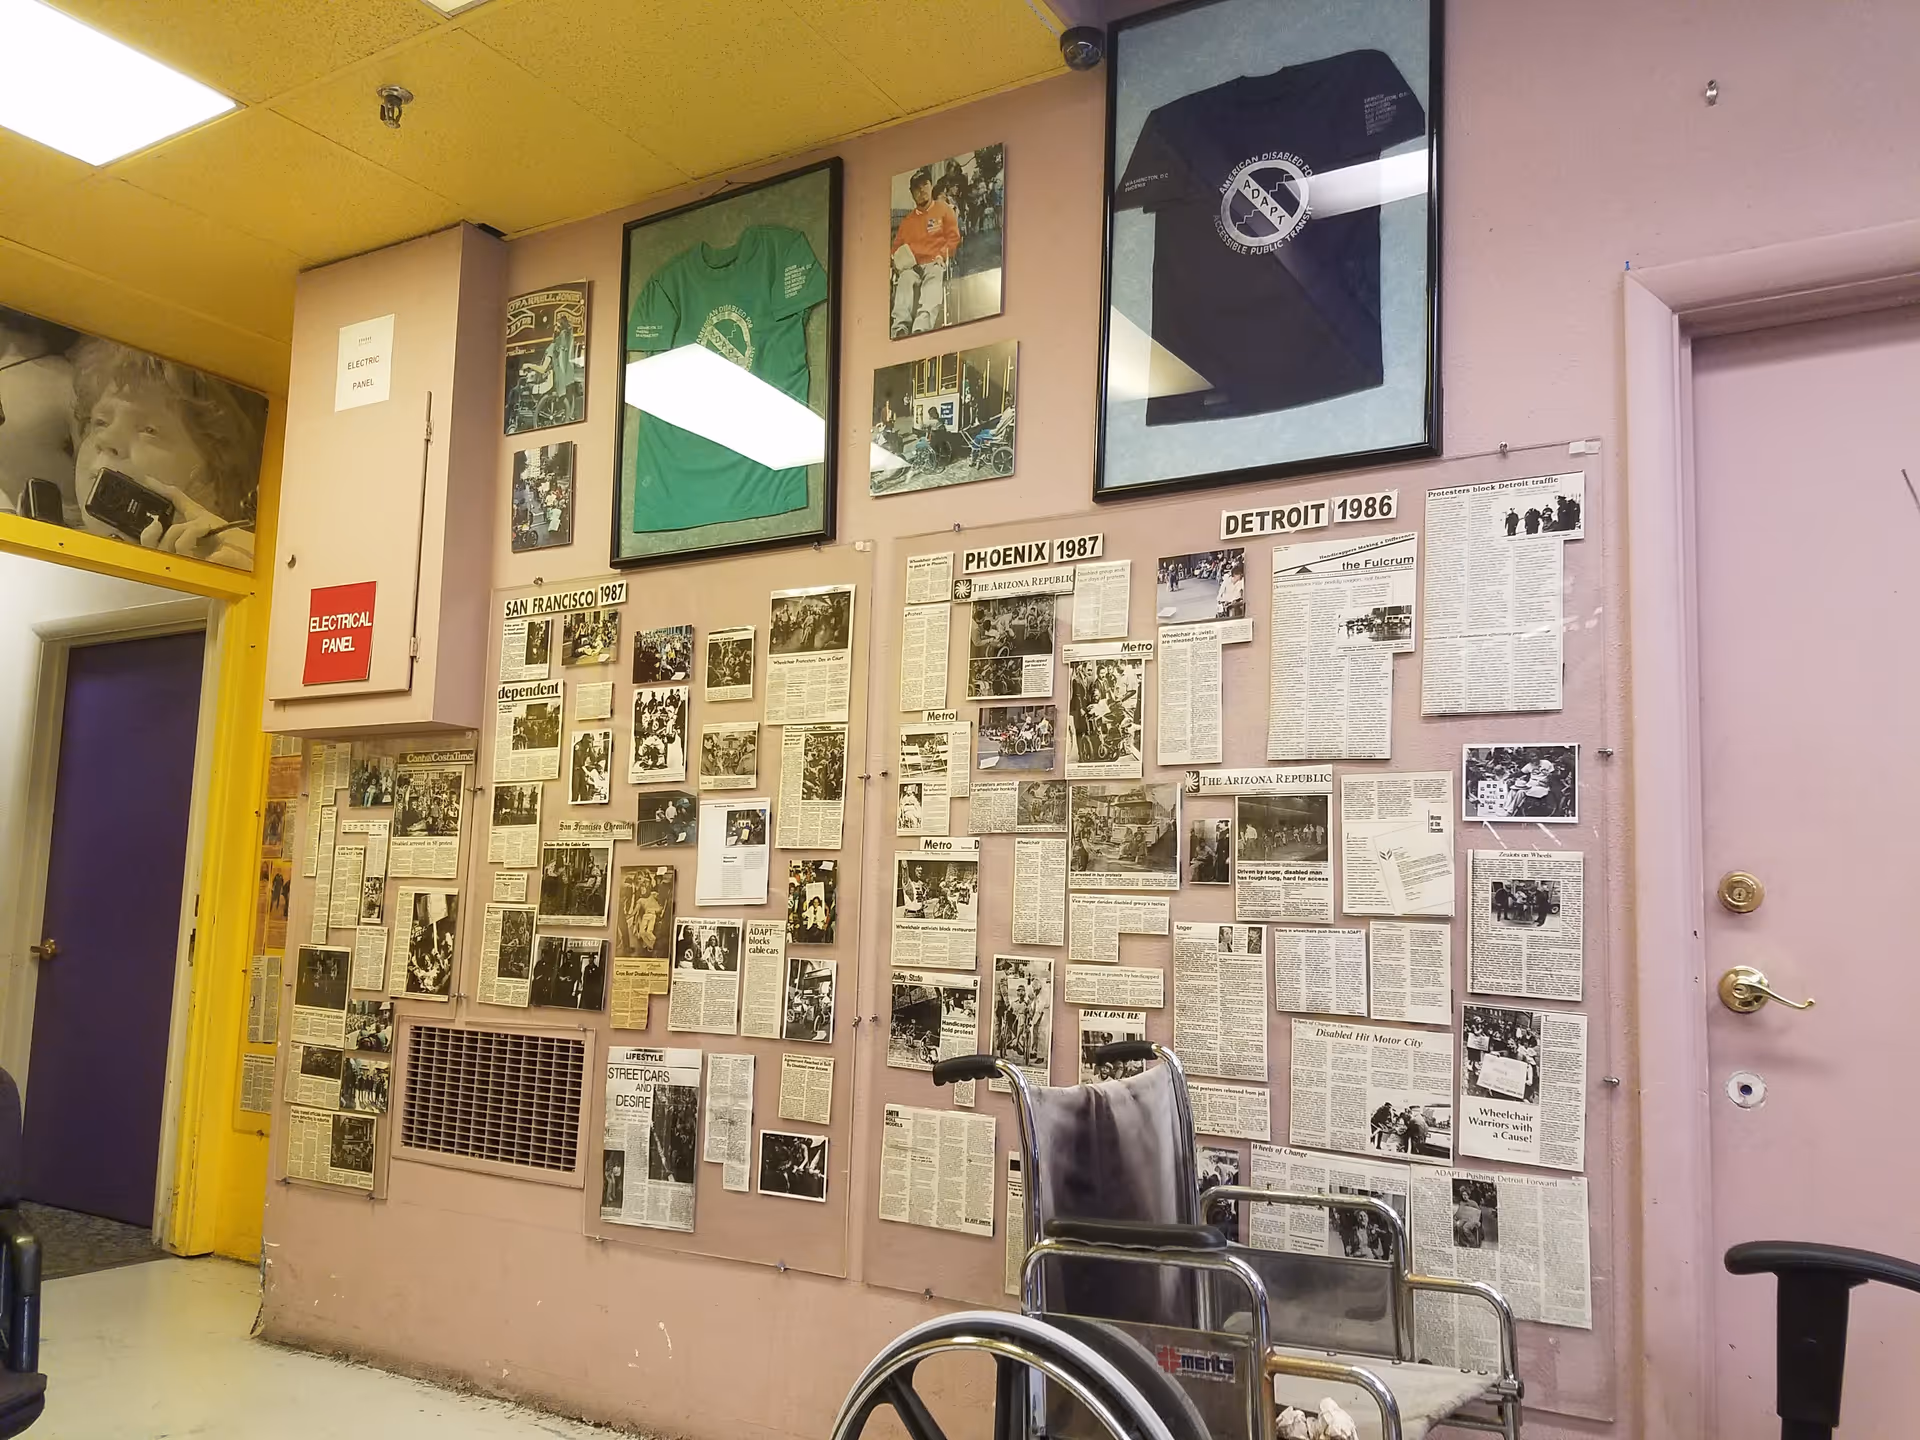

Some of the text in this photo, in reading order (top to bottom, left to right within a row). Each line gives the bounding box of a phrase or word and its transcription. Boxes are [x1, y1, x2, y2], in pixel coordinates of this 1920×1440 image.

[1219, 155, 1259, 194] AMERICAN
[1262, 151, 1304, 167] DISABLED
[1242, 179, 1286, 226] ADAPT
[1213, 205, 1314, 255] ACCESSIBLE PUBLIC TRANSIT
[347, 355, 380, 370] ELECTRIC
[352, 378, 374, 390] PANEL
[1428, 476, 1559, 498] Protesters block Detroit traffic
[1225, 495, 1393, 536] DETROIT 1986
[965, 536, 1100, 570] PHOENIX 1987
[1342, 556, 1414, 571] the Fulcrum
[972, 574, 1074, 593] THE ARIZONA REPUBLIC
[505, 583, 624, 617] SAN FRANCISCO 1987
[310, 611, 372, 632] ELECTRICAL
[322, 636, 355, 653] PANEL
[1121, 643, 1152, 653] Metro
[498, 681, 559, 701] dependent
[927, 711, 955, 721] Metro
[1200, 773, 1332, 786] THE ARIZONA REPUBLIC
[559, 821, 571, 831] San
[573, 821, 602, 831] Francisco
[924, 839, 980, 850] Metro D
[749, 927, 772, 936] ADAPT
[749, 936, 770, 945] blocks
[766, 947, 779, 955] cars
[1083, 1010, 1141, 1020] DISCLOSURE
[942, 1020, 976, 1029] Handicapped
[1316, 1028, 1424, 1048] Disabled Hit Motor City
[625, 1052, 664, 1062] LIFESTYLE
[608, 1067, 670, 1083] STREETCARS
[635, 1083, 652, 1092] AND
[616, 1094, 651, 1108] DESIRE
[1479, 1107, 1533, 1122] Wheelchair
[1468, 1116, 1533, 1132] Warriors with
[1501, 1131, 1533, 1143] Cause!
[1252, 1143, 1308, 1158] Wheels of Change
[1466, 1172, 1558, 1188] Pushing Detroit Forward
